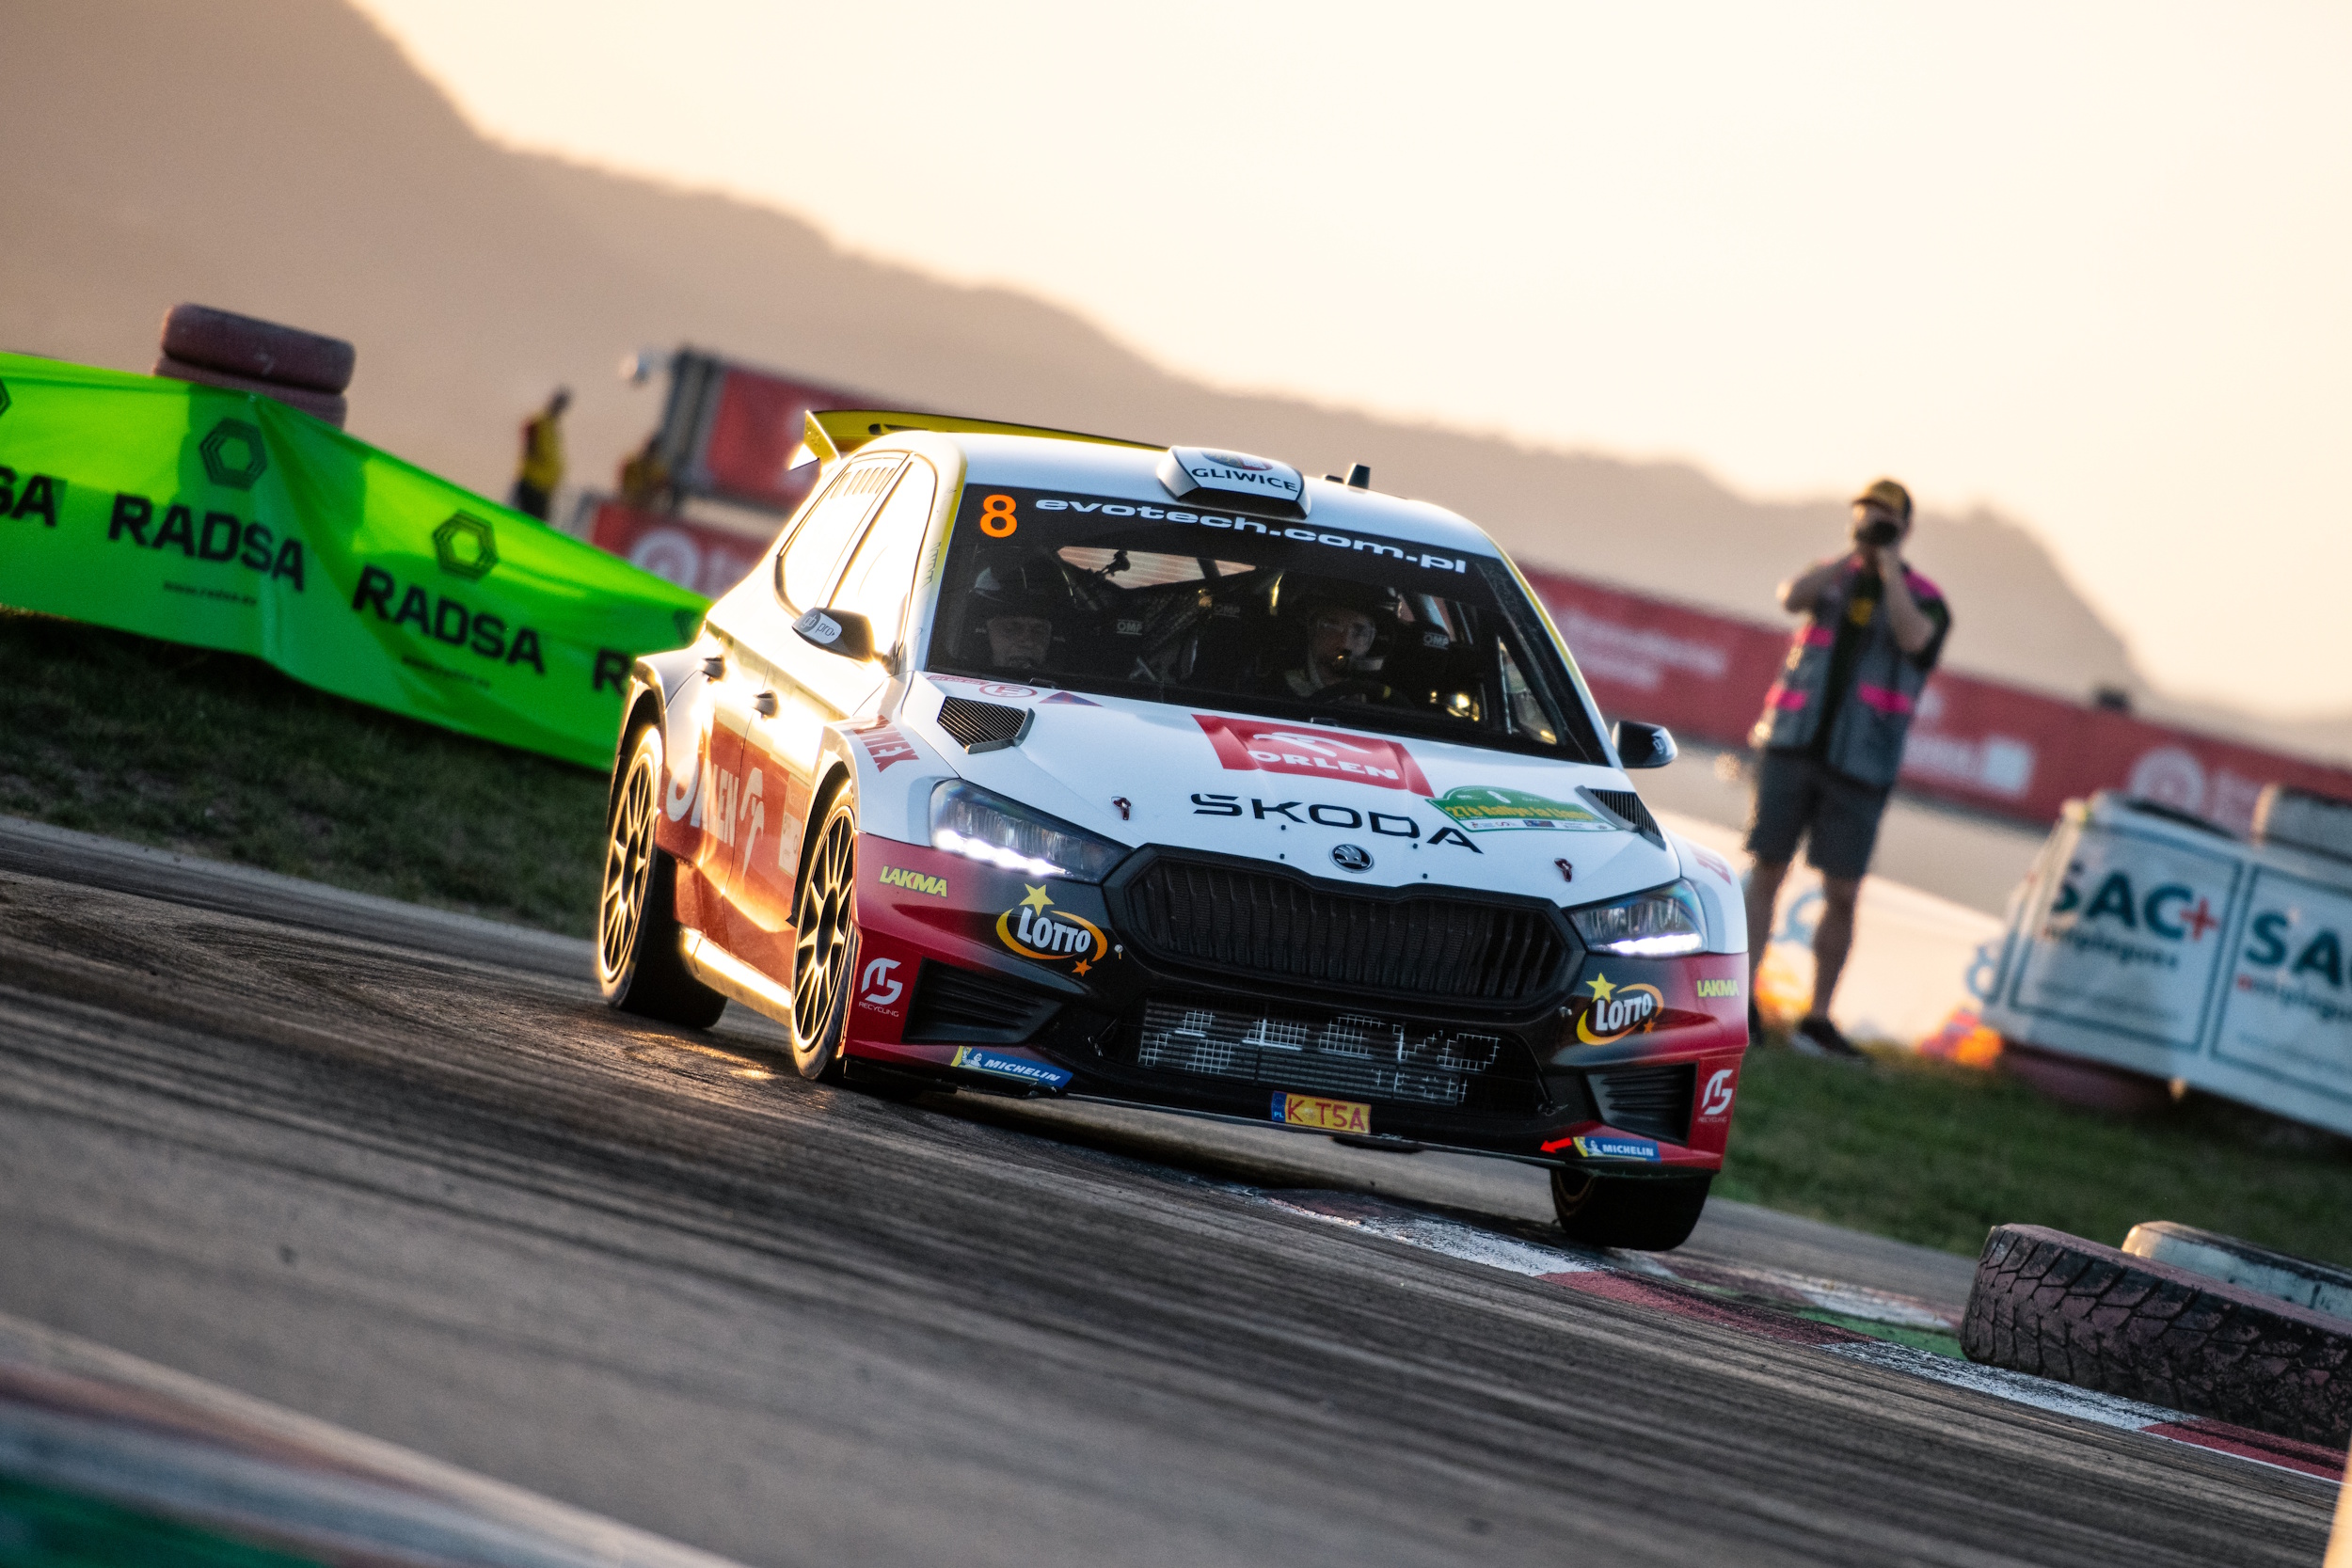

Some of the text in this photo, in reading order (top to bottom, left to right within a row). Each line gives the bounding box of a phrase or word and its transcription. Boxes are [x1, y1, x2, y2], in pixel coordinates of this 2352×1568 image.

[1191, 468, 1298, 492] GLIWICE
[979, 494, 1017, 538] 8
[108, 492, 304, 594] RADSA
[1035, 499, 1467, 574] evotech.com.pl
[352, 563, 545, 675] RADSA
[1248, 750, 1399, 780] ORLEN
[879, 865, 948, 897] LAKMA
[1016, 907, 1091, 954] LOTTO
[1696, 979, 1740, 998] LAKMA
[858, 1001, 899, 1018] RECYCLING
[1595, 993, 1653, 1032] LOTTO
[983, 1058, 1061, 1083] MICHELIN
[1602, 1143, 1654, 1157] MICHELIN
